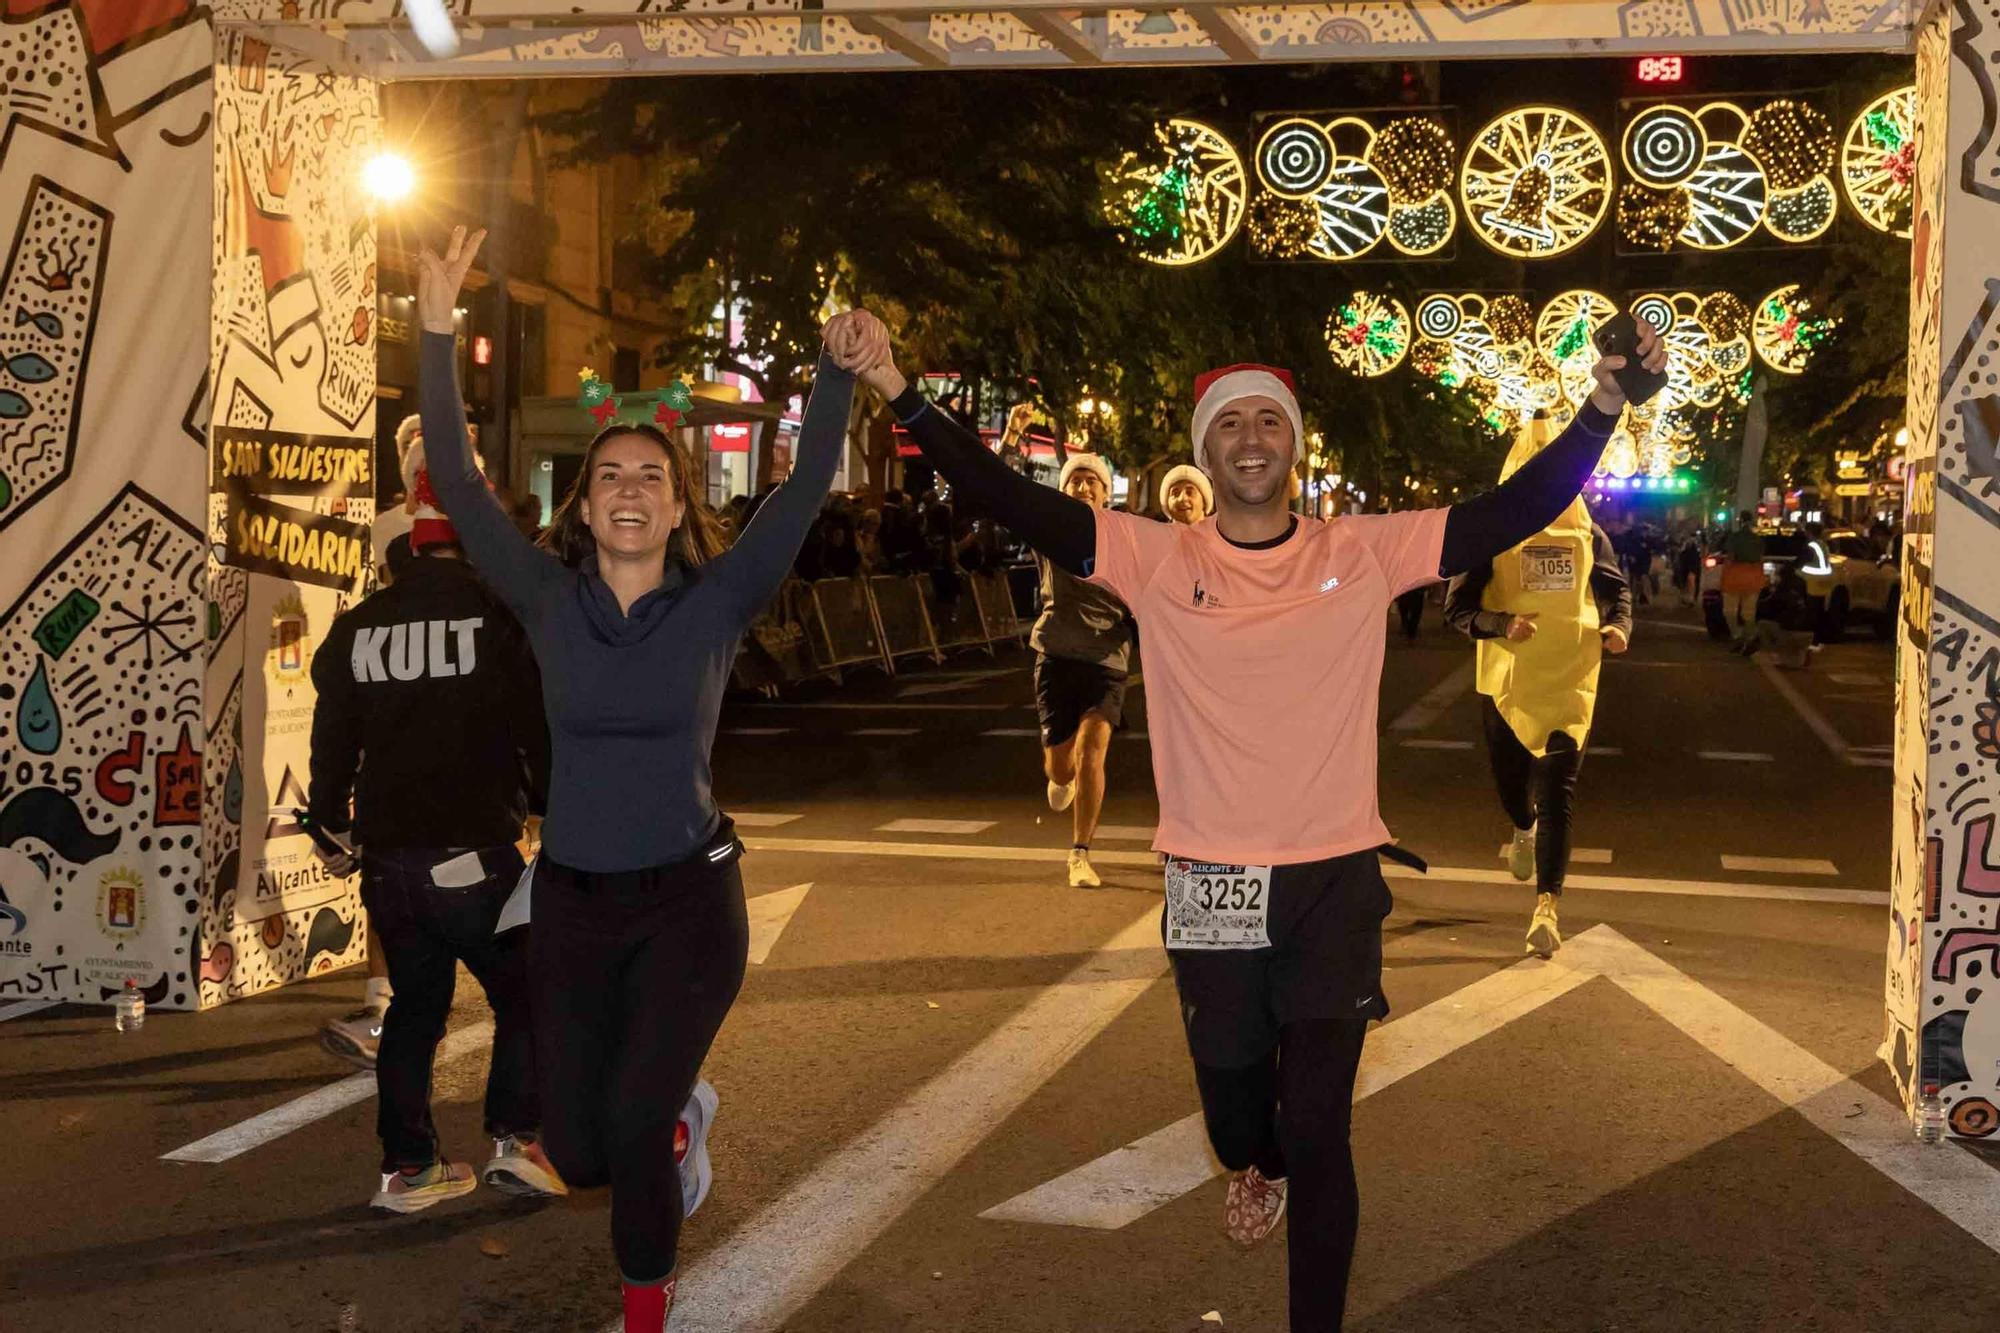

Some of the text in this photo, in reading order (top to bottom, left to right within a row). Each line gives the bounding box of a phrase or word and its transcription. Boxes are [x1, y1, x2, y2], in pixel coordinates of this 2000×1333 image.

[1638, 57, 1682, 81] 19:53
[326, 360, 361, 406] RUN
[223, 439, 370, 483] SAN SILVESTRE
[238, 510, 363, 578] SOLIDARIA
[1540, 560, 1572, 575] 1055
[351, 617, 484, 683] KULT
[256, 862, 331, 897] Alicante
[1192, 864, 1231, 873] ALICANTE
[1200, 877, 1262, 911] 3252
[84, 957, 154, 969] AYUNTAMIENTO
